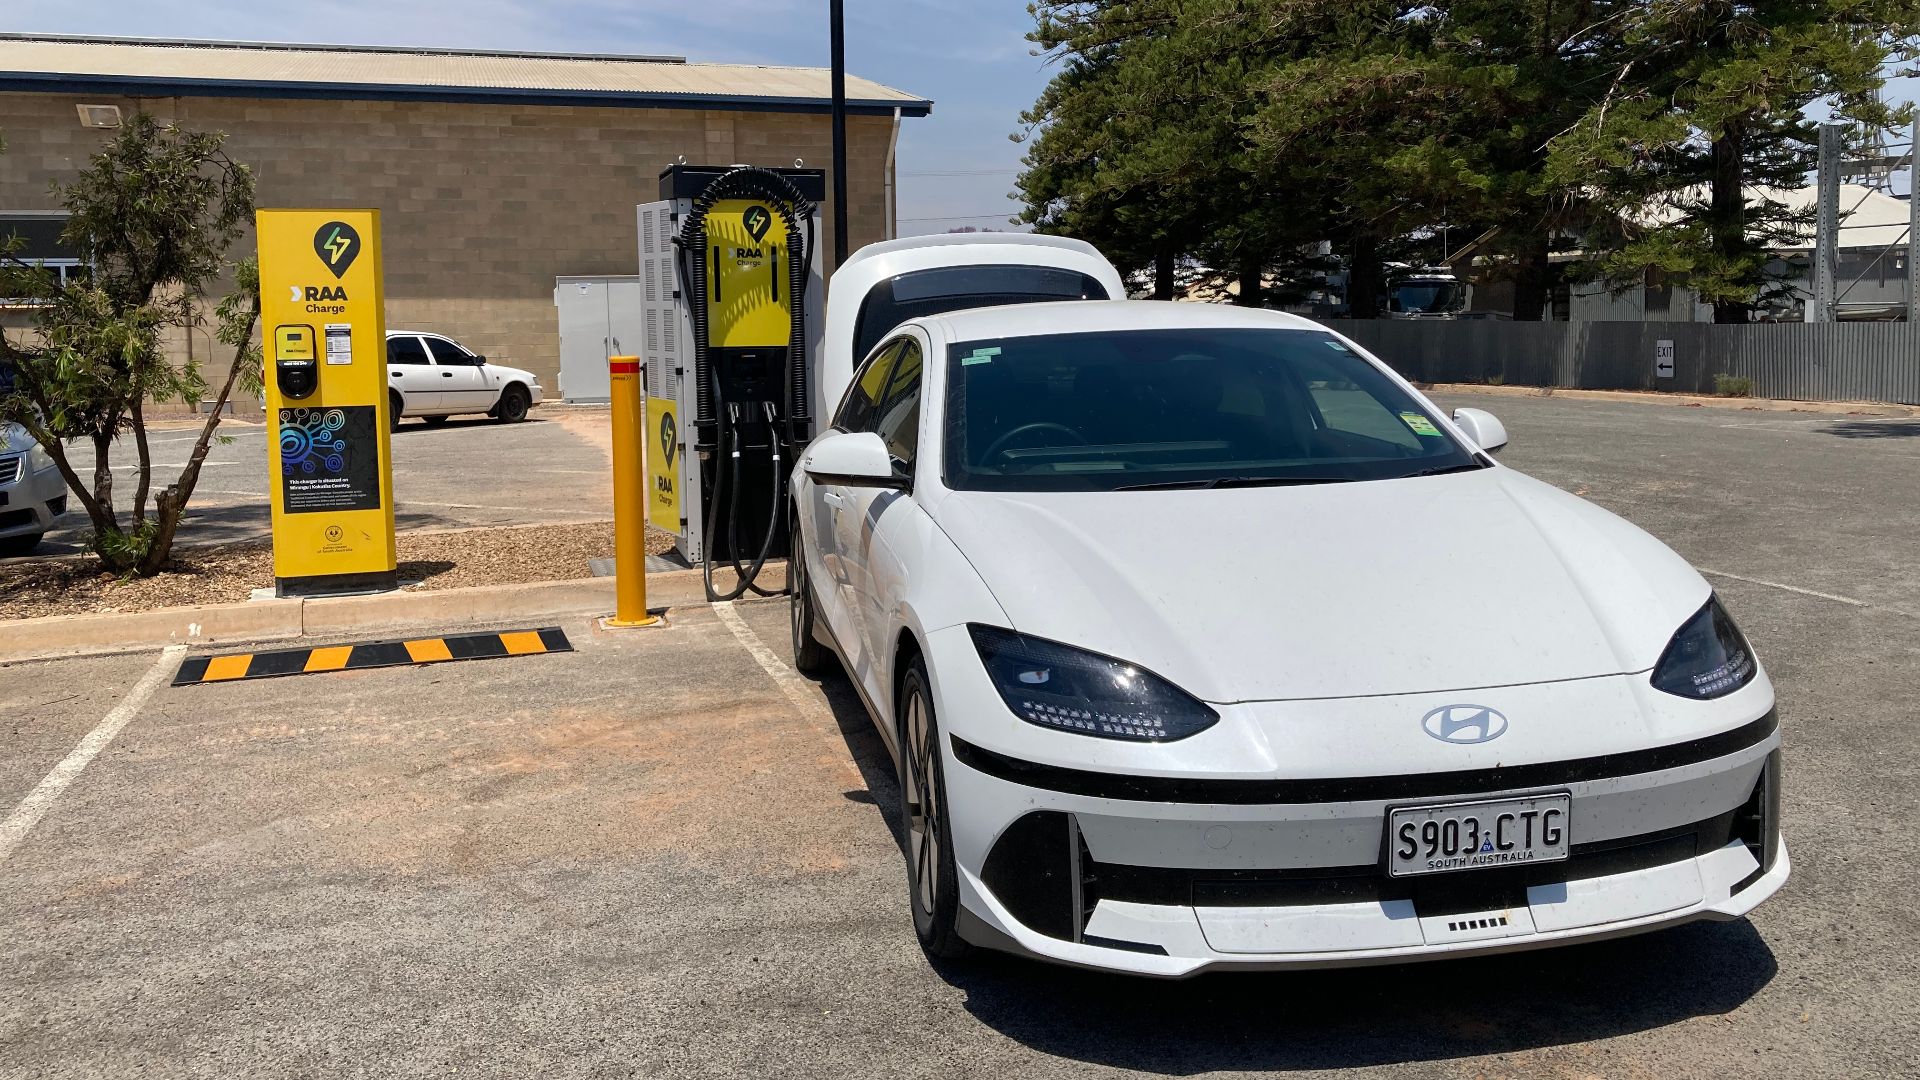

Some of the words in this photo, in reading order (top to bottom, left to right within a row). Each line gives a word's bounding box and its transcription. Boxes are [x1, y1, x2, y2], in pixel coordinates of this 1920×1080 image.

[737, 248, 763, 258] RAA
[305, 286, 348, 301] RAA
[306, 304, 345, 315] Charge
[1658, 346, 1672, 357] EXIT
[658, 475, 673, 494] RAA
[1496, 809, 1561, 851] CTG
[1428, 858, 1466, 869] SOUTH
[1472, 850, 1534, 865] AUSTRALIA
